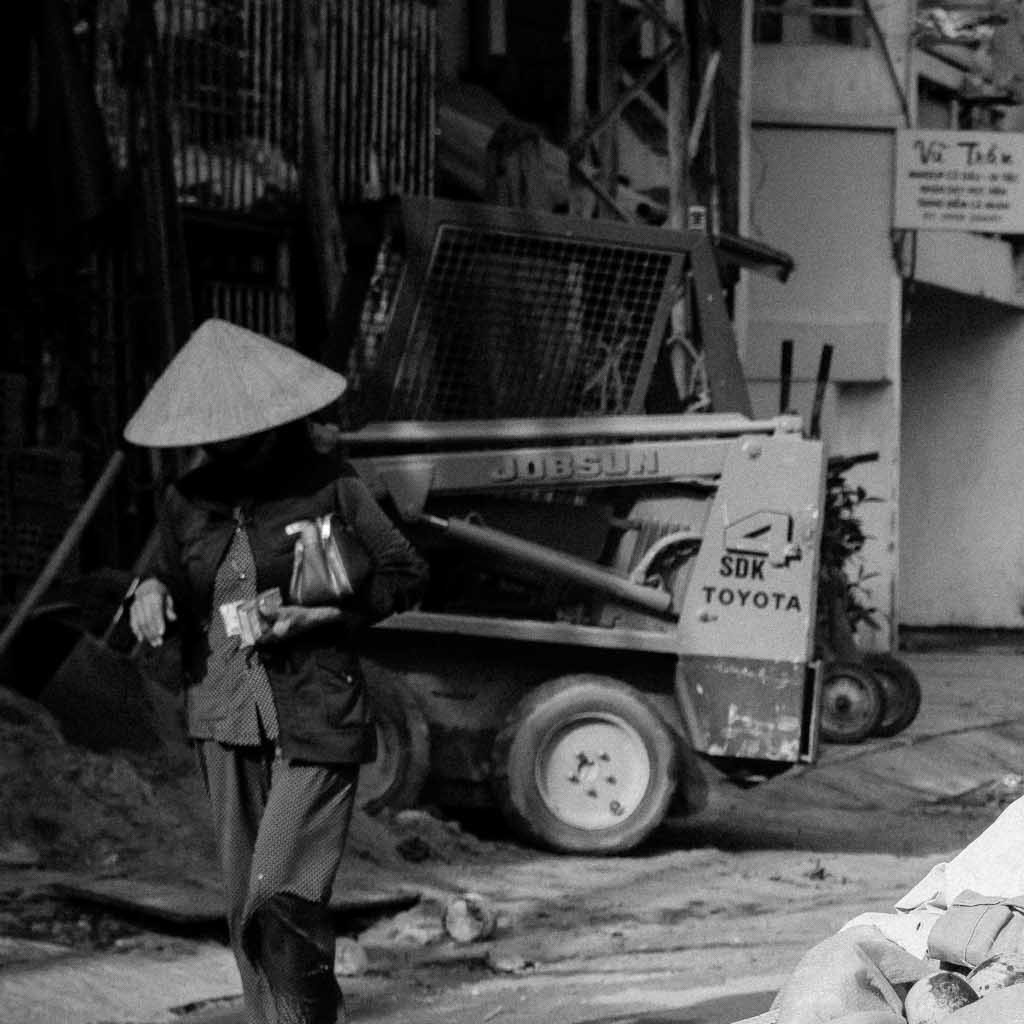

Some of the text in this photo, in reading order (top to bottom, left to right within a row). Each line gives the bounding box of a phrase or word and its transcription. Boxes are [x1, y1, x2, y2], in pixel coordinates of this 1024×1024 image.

[490, 449, 661, 484] JOBSUN
[719, 555, 765, 581] SDK
[702, 586, 802, 612] TOYOTA
